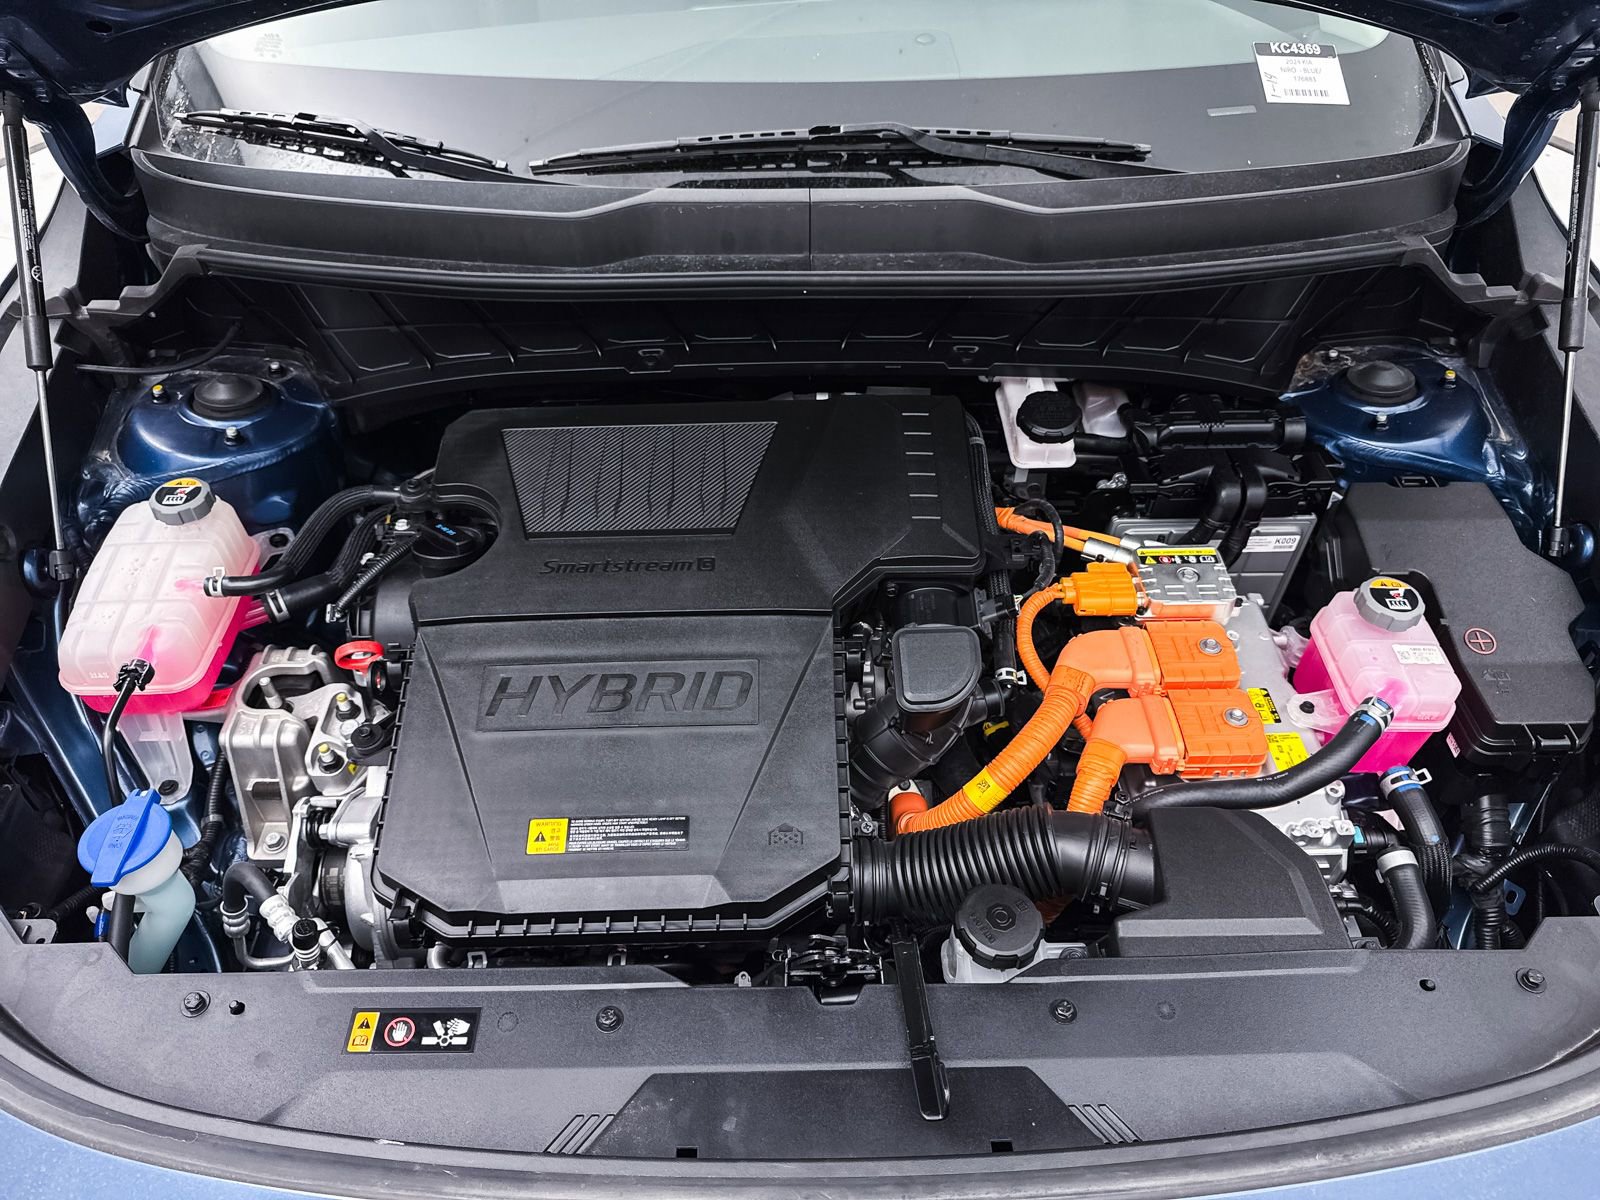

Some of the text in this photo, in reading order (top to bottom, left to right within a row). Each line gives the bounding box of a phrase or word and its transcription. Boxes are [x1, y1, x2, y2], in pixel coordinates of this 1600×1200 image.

[1269, 42, 1321, 54] KC4369
[539, 558, 694, 574] Smartstream
[484, 670, 754, 718] HYBRID
